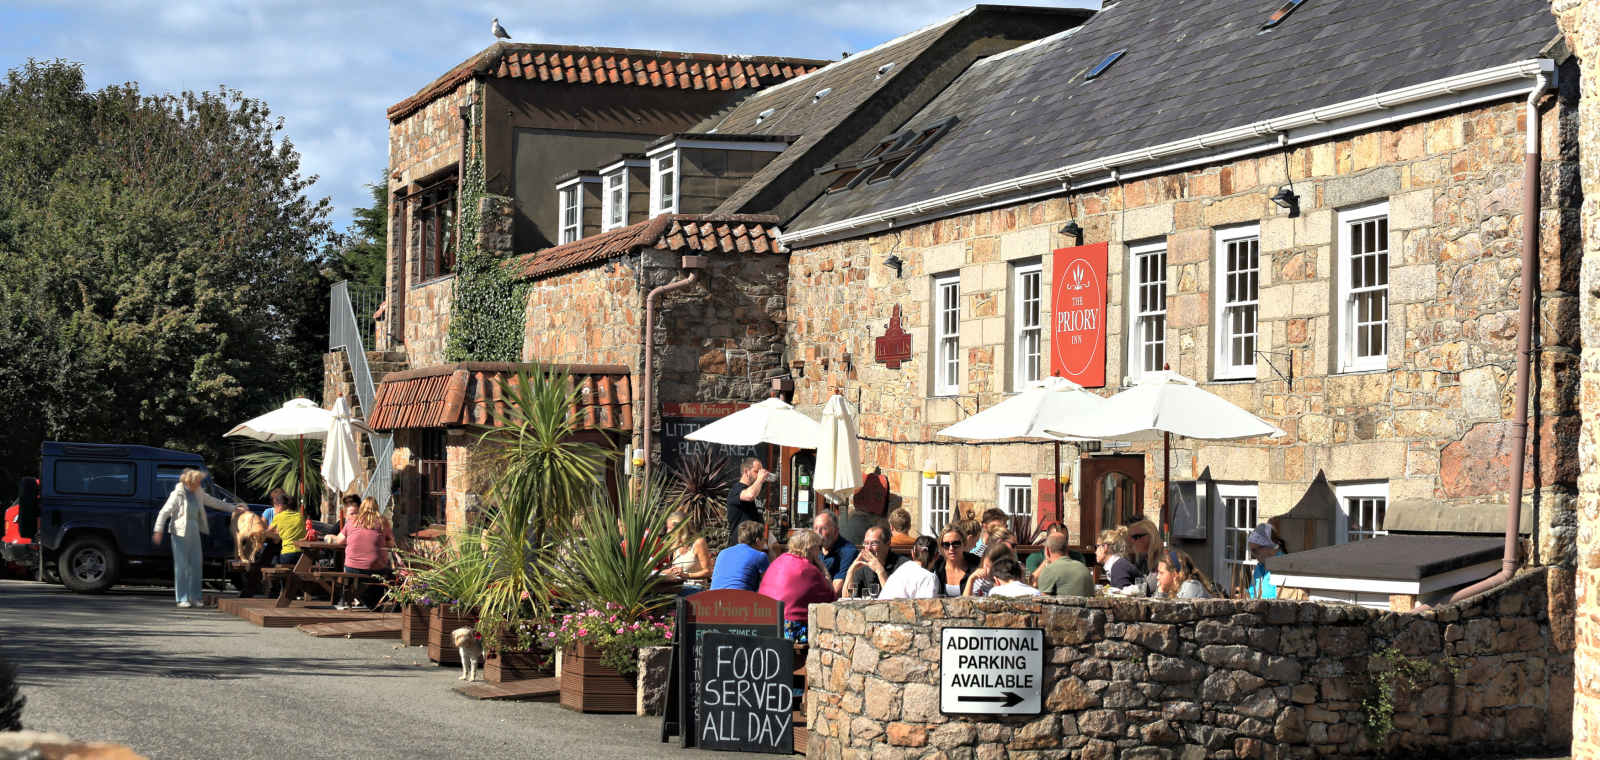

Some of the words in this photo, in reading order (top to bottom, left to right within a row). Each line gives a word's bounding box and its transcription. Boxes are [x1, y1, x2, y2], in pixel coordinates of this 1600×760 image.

[1072, 296, 1084, 306] THE
[1058, 308, 1098, 332] PRIORY
[1072, 335, 1082, 344] INN
[679, 402, 697, 415] The
[699, 402, 733, 416] Priory
[719, 444, 758, 456] AREA
[690, 600, 711, 616] The
[713, 600, 750, 621] Priory
[753, 601, 772, 617] Inn
[946, 636, 1039, 651] ADDITIONAL
[717, 645, 780, 680] FOOD
[958, 655, 1026, 669] PARKING
[951, 673, 1033, 688] AVAILABLE
[704, 679, 793, 712] SERVED
[702, 710, 740, 742] ALL
[748, 711, 791, 747] DAY
